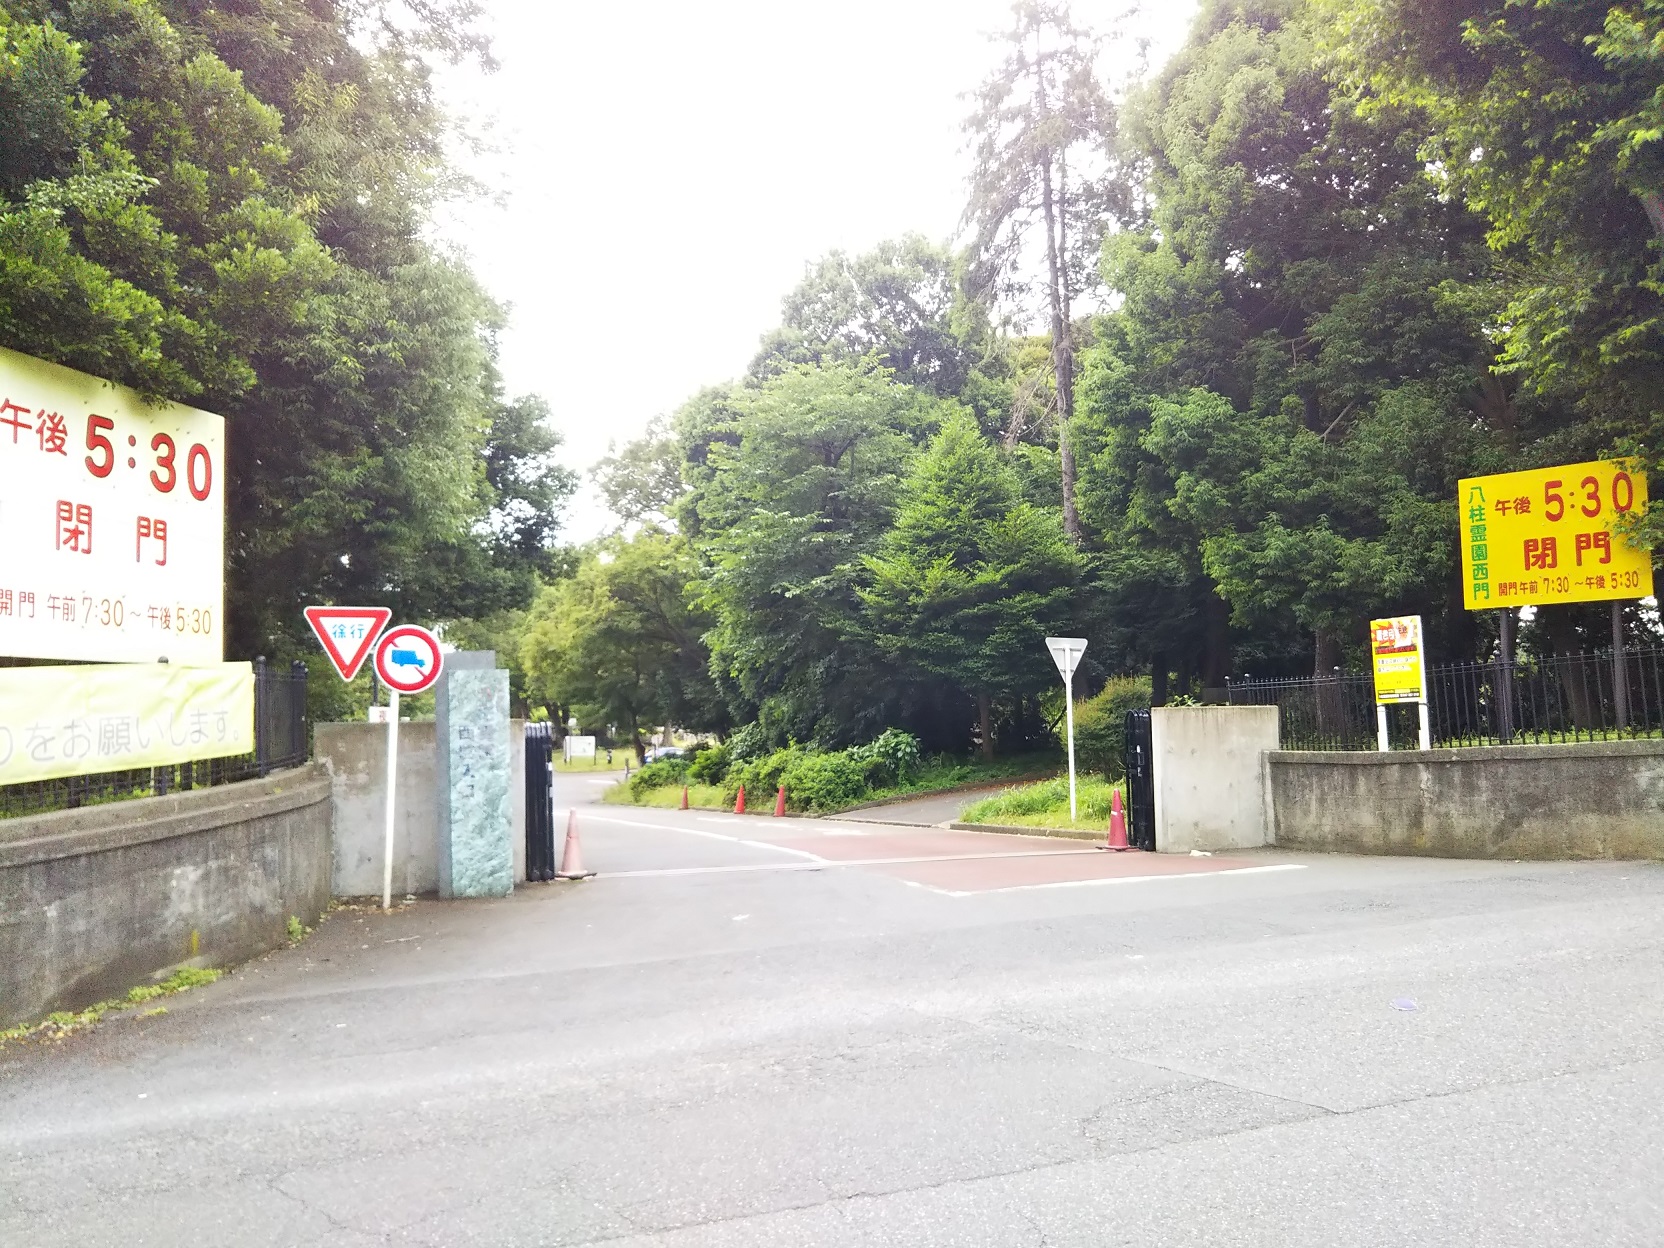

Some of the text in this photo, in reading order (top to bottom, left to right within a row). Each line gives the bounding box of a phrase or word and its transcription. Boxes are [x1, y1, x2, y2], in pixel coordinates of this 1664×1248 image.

[1468, 486, 1490, 600] 八柱霊園西門
[331, 623, 366, 639] 徐行
